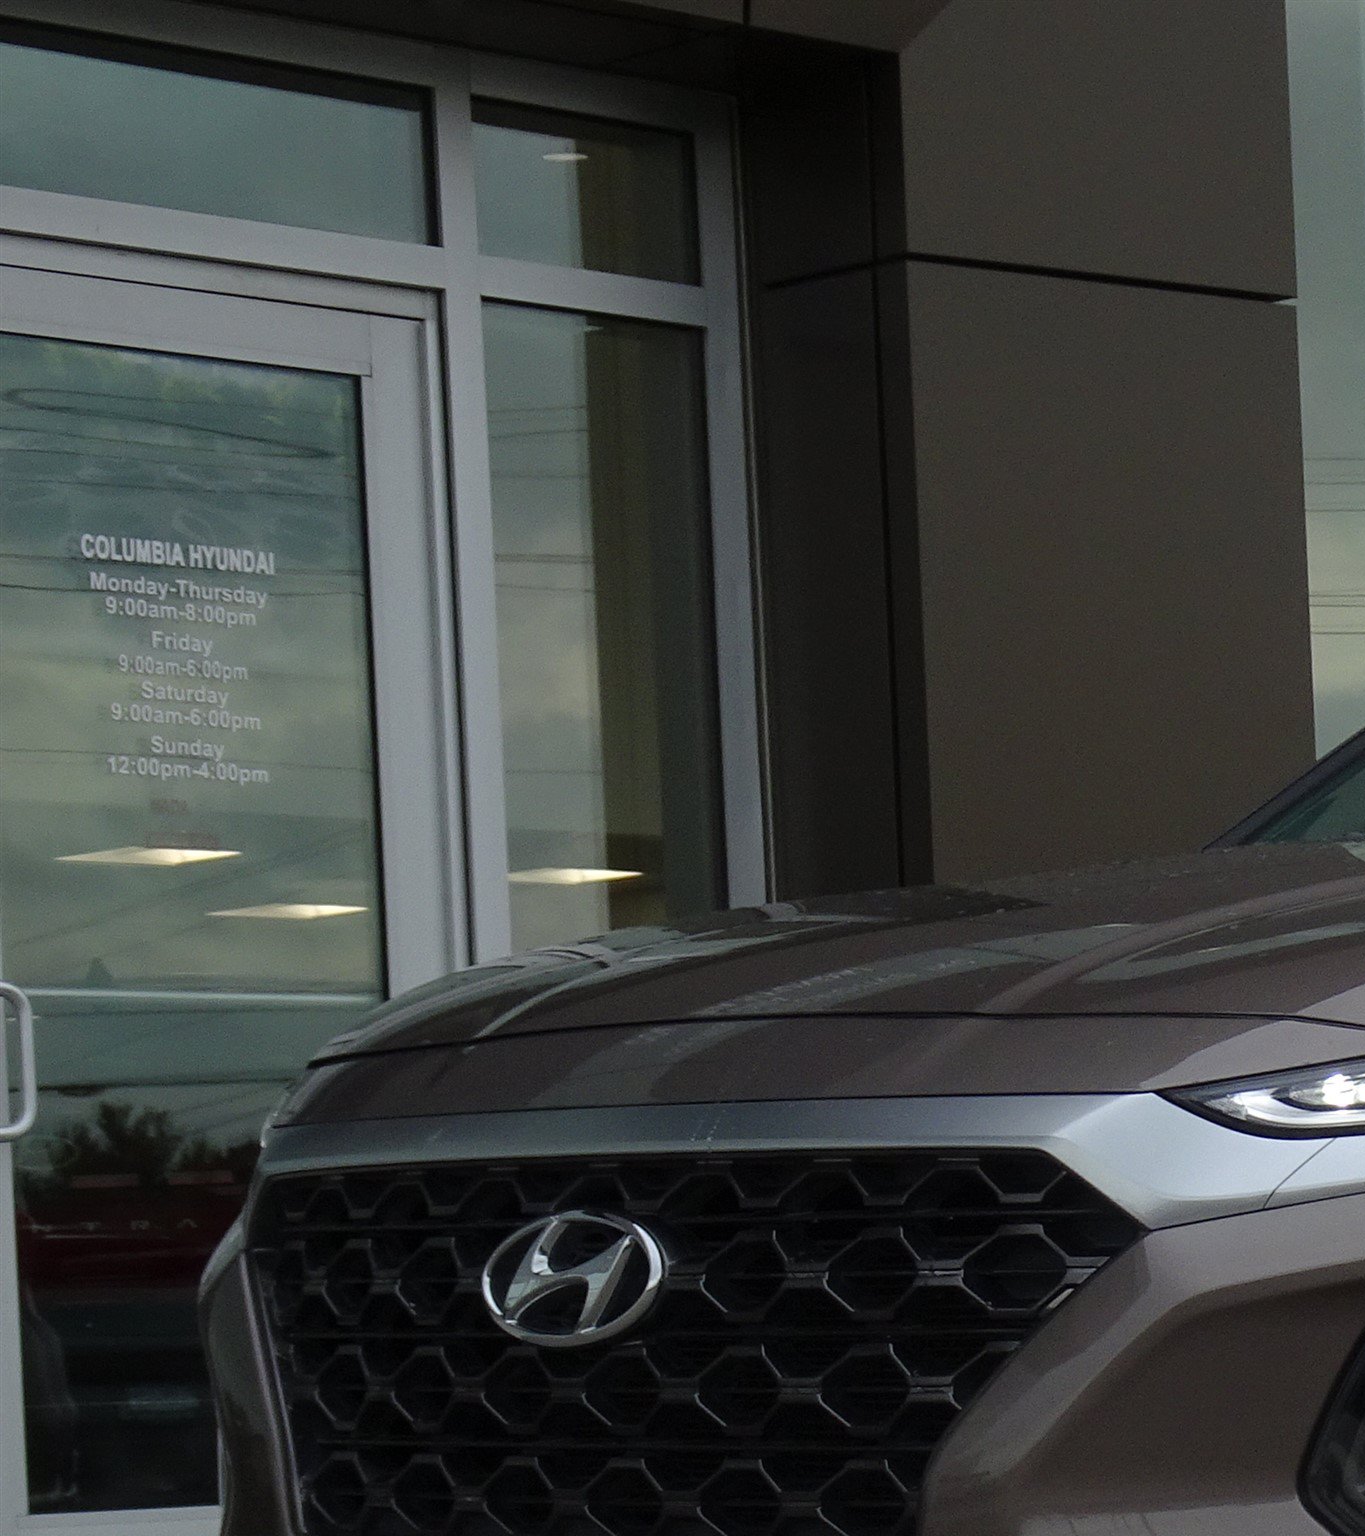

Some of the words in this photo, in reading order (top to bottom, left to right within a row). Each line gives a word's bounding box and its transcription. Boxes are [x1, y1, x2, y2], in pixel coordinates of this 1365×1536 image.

[80, 533, 185, 567] COLUMBIA
[189, 545, 275, 575] HYUNDAI
[90, 572, 268, 608] Monday-Thursday
[105, 597, 256, 627] 9:00am-8:00pm
[151, 631, 213, 656] Friday
[118, 654, 249, 682] 9:00am-6:00pm
[141, 682, 229, 708] Saturday
[110, 703, 261, 732] 9:00am-6:00pm
[151, 736, 224, 762] Sunday
[107, 756, 269, 785] 12:00pm-4:00pm
